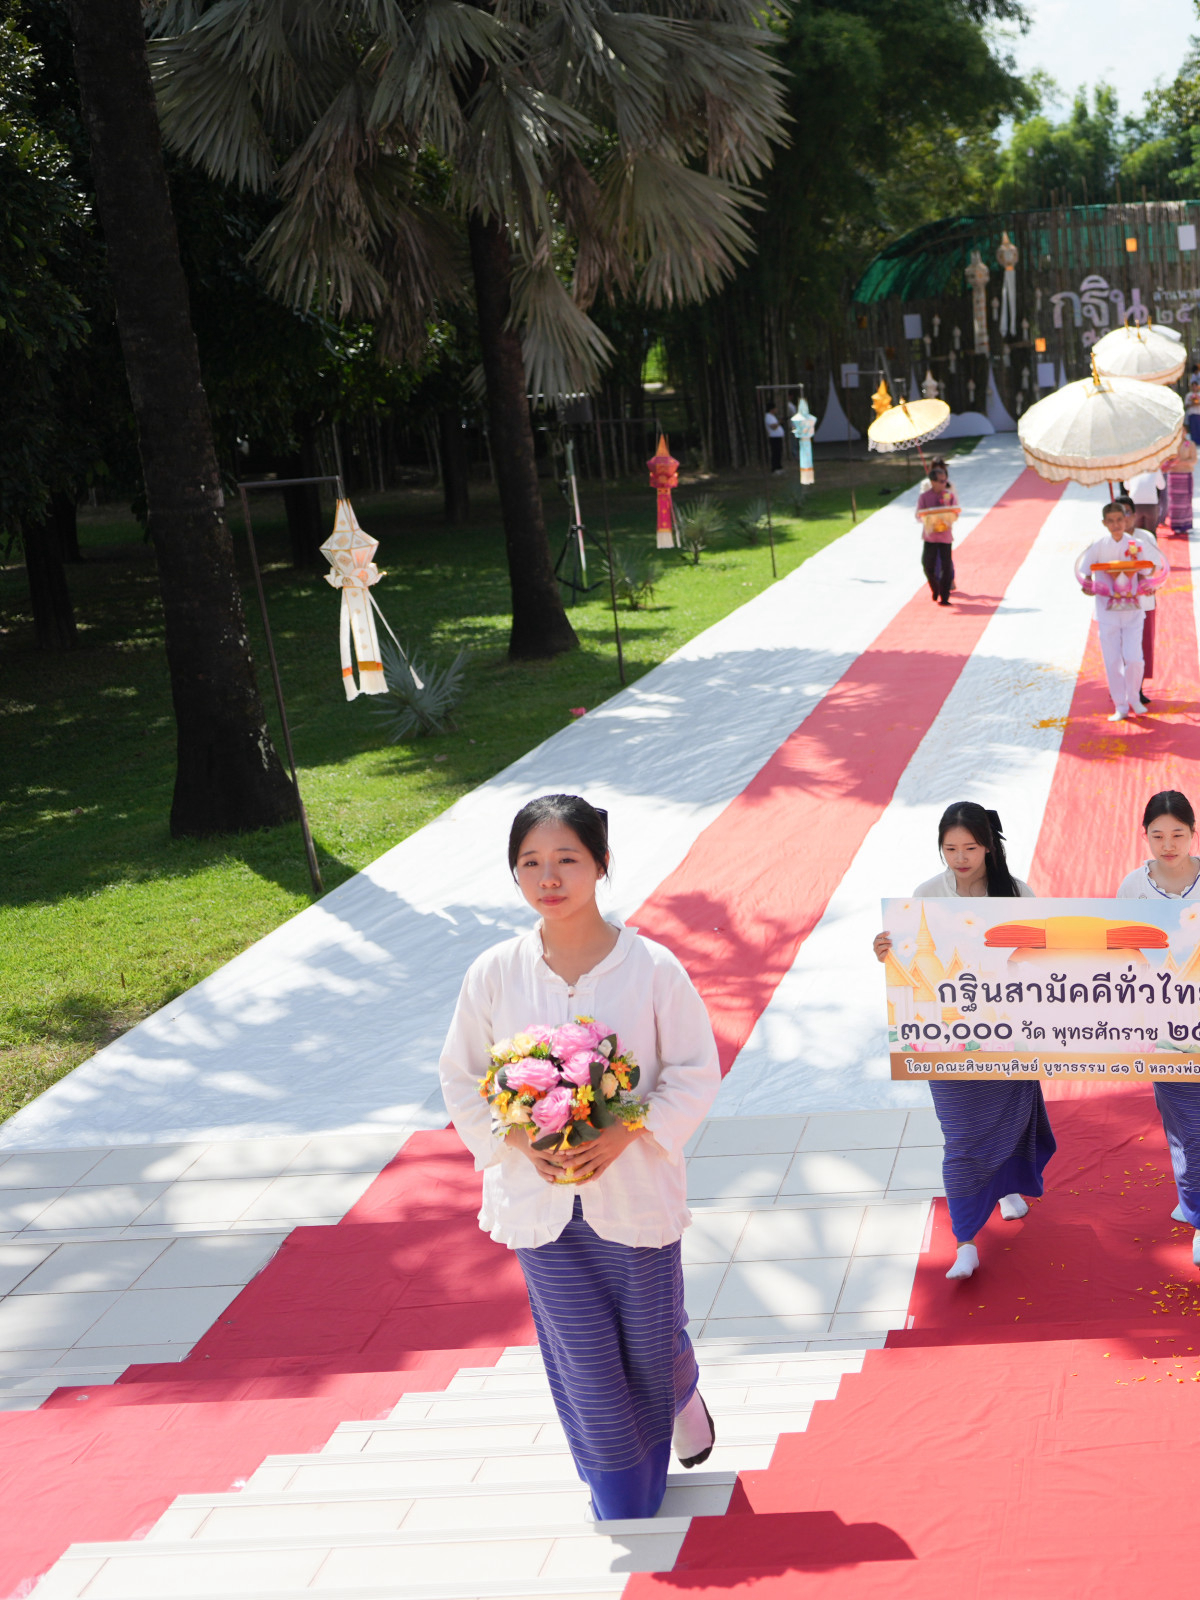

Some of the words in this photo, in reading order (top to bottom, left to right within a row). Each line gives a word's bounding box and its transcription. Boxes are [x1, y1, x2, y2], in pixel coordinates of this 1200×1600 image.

[1049, 275, 1149, 347] กฐิน
[901, 1021, 1013, 1043] ๓๐,๐๐๐
[1022, 1019, 1046, 1040] วัด
[1052, 1021, 1158, 1046] พุทธศักราช
[906, 1059, 931, 1072] โดย
[936, 1059, 1038, 1075] คณะศิษยานุศิษย์
[1044, 1062, 1105, 1076] บูชาธรรม
[1111, 1063, 1129, 1073] ๘๑
[1135, 1061, 1144, 1073] ปี
